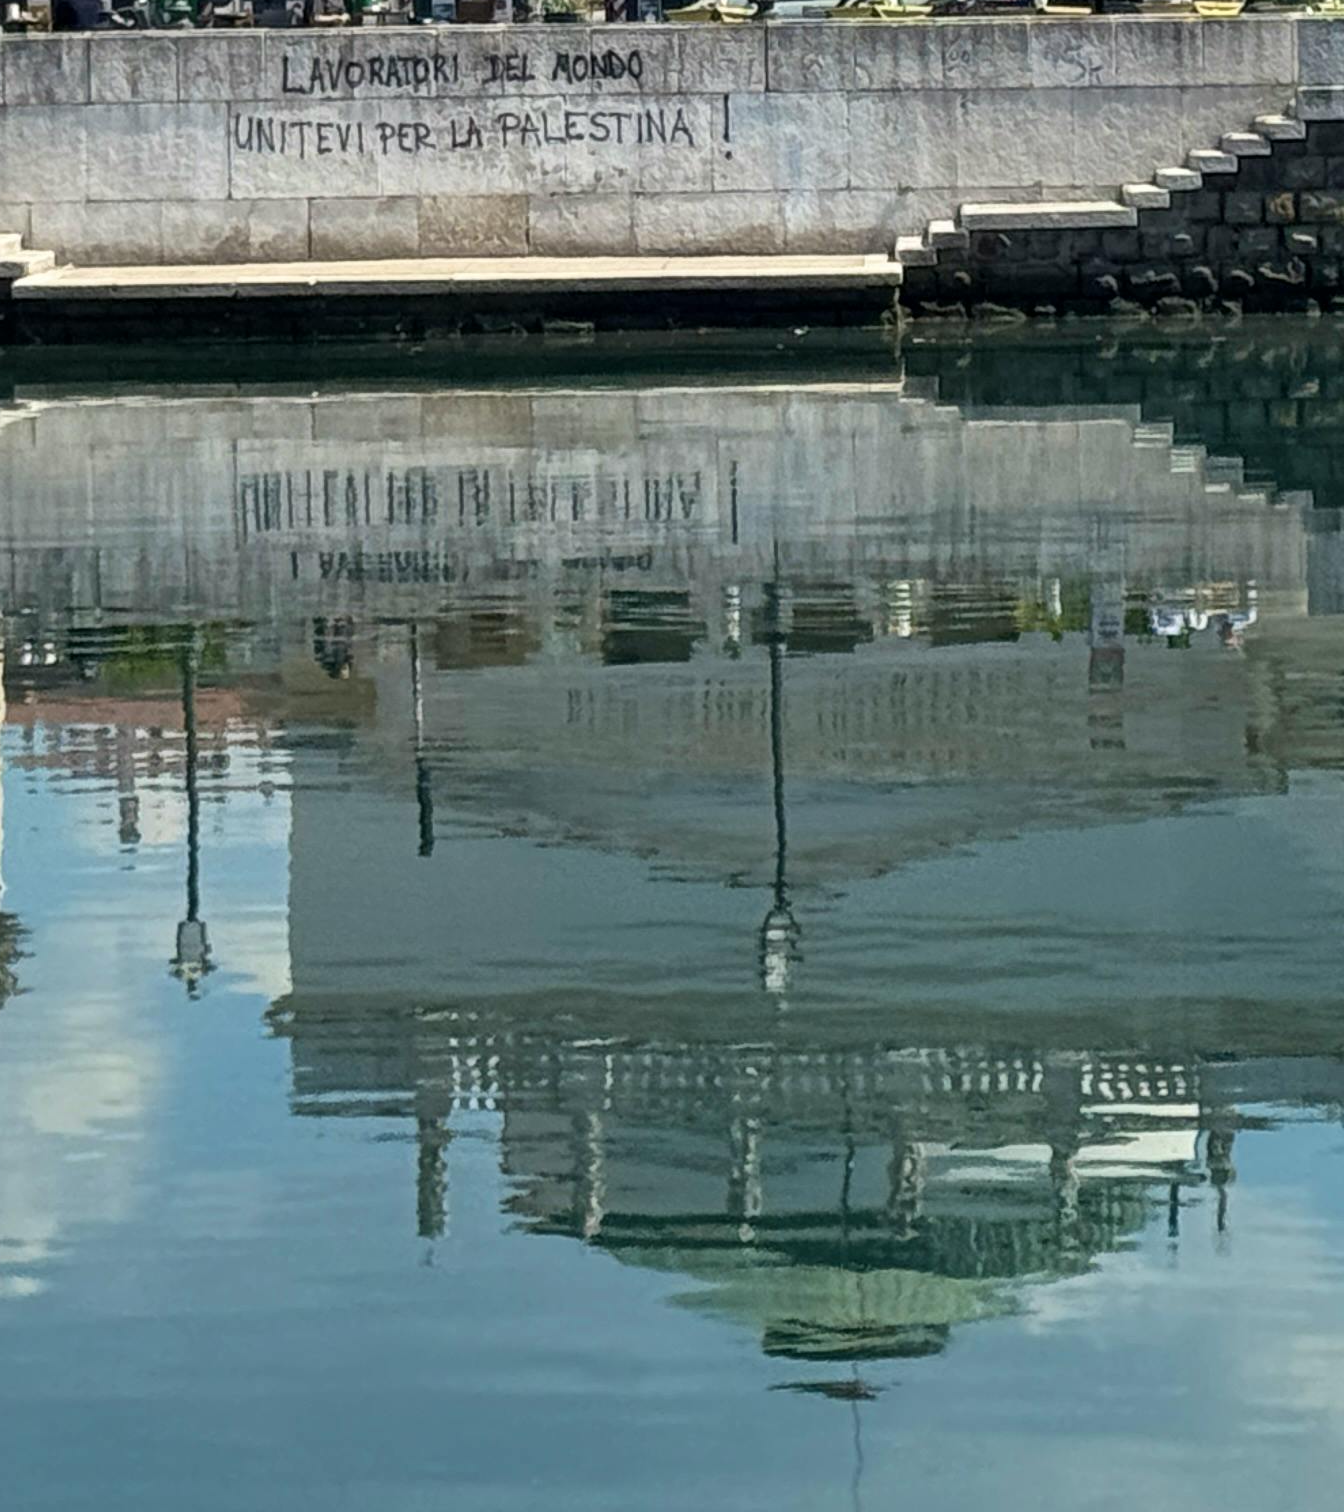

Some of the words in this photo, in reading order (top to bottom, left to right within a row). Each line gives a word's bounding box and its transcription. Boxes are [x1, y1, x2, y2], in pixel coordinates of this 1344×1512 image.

[282, 53, 459, 94] LAVORATORI
[483, 52, 536, 84] DEL
[552, 48, 644, 84] MONDO
[234, 112, 365, 160] UNITEVI
[375, 121, 437, 156] PER
[451, 115, 484, 149] LA
[497, 107, 696, 149] PALESTINA
